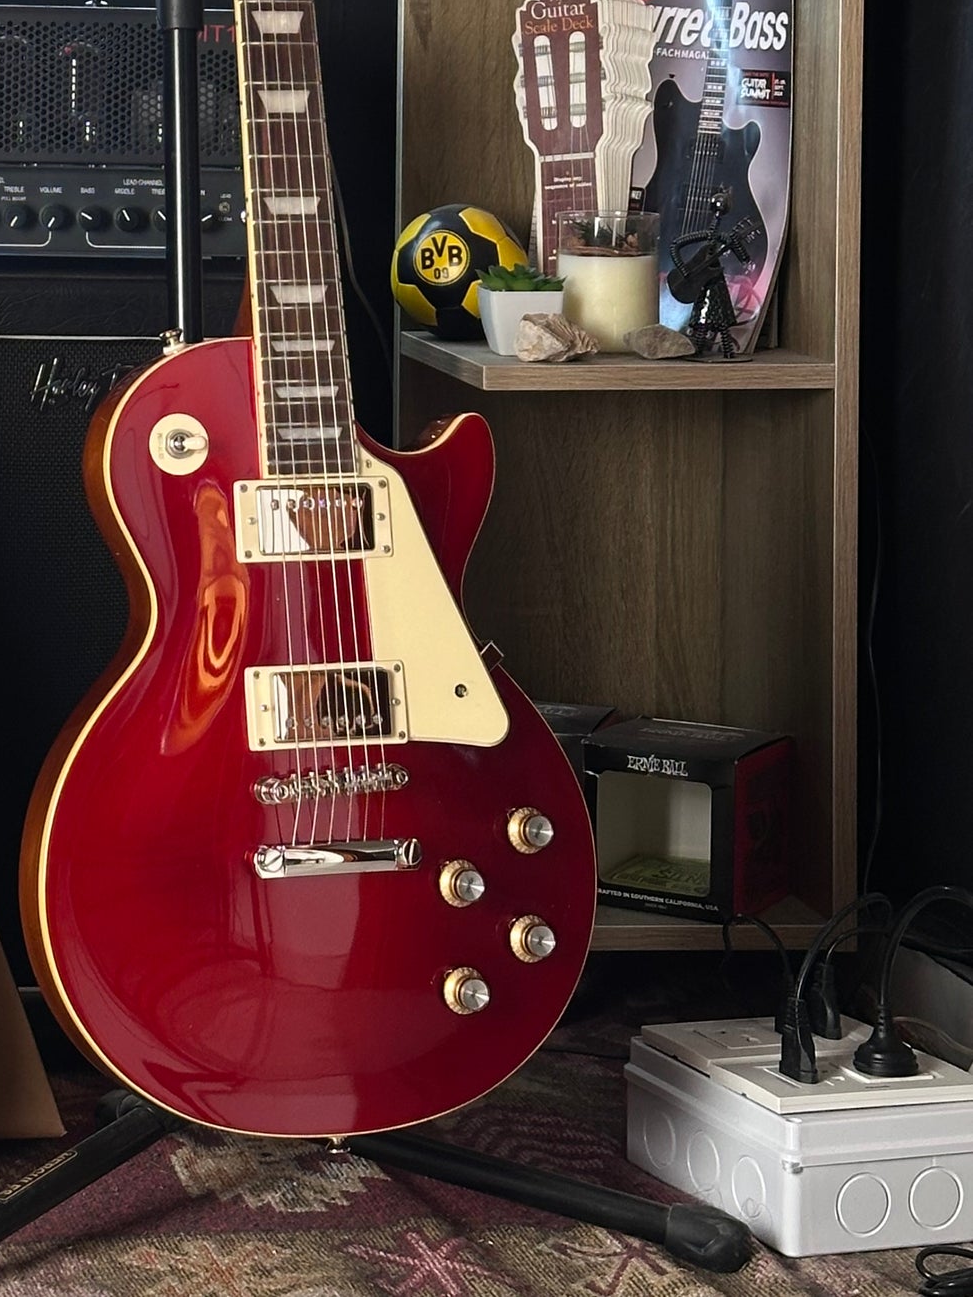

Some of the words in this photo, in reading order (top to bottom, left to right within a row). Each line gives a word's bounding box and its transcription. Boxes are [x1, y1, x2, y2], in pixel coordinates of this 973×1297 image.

[531, 1, 586, 20] Guitar
[524, 19, 558, 35] Scale
[562, 15, 594, 31] Deck
[729, 1, 789, 51] Bass
[656, 47, 709, 60] FACHMAGA
[740, 88, 771, 101] SUMMIT
[39, 186, 63, 194] VOLUME
[421, 235, 463, 270] BVB
[433, 267, 450, 280] 09
[627, 754, 660, 774] ERNIE
[661, 759, 689, 777] BALL
[597, 887, 622, 897] RAFTED
[630, 893, 664, 903] SOUTHERN
